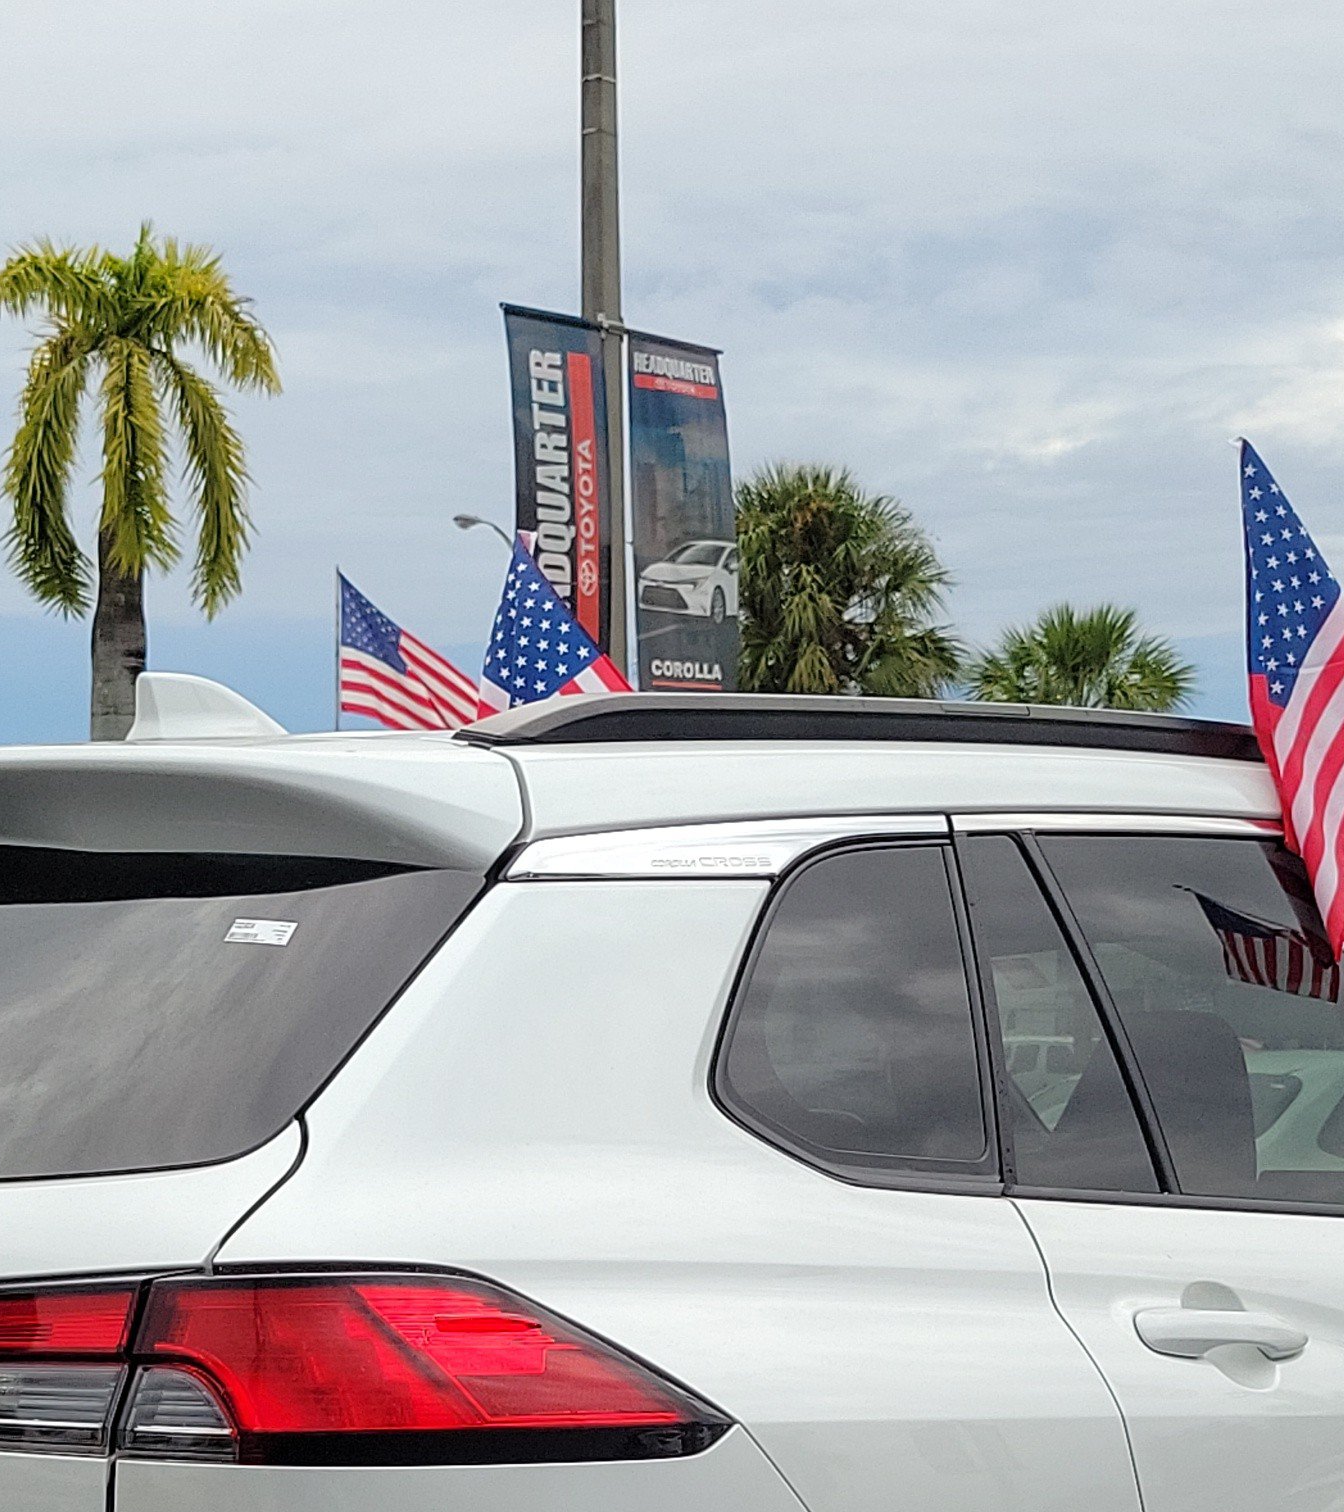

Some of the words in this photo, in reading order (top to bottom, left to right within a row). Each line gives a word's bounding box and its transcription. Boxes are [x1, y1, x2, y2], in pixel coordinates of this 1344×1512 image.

[529, 349, 576, 605] DQUARTER
[577, 439, 596, 556] TOYOTA
[651, 659, 723, 681] COROLLA
[699, 856, 772, 867] CROSS
